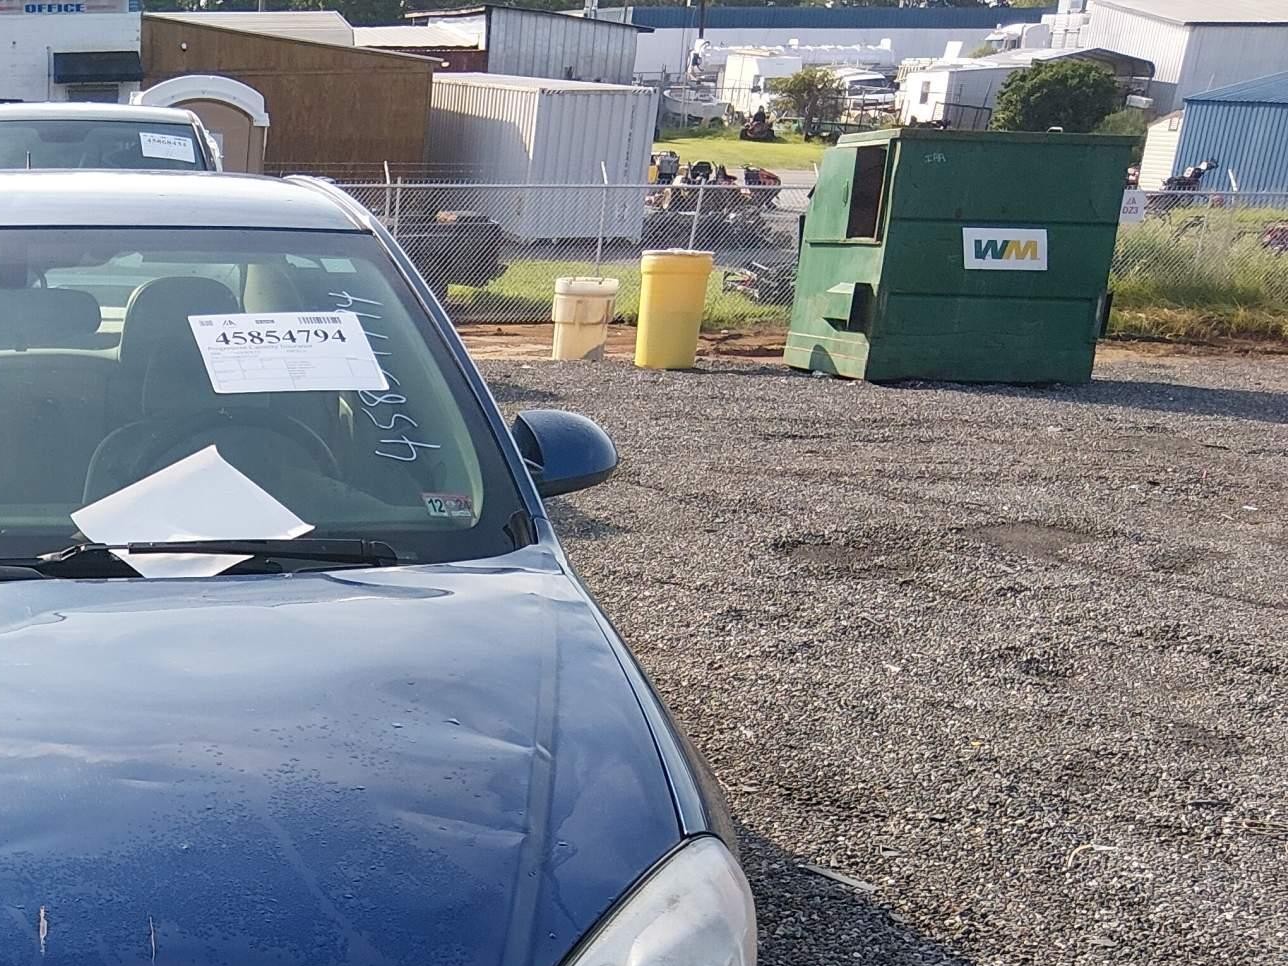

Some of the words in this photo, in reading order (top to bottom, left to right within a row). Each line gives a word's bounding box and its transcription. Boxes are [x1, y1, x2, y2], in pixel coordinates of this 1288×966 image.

[24, 3, 86, 13] OFFICE
[974, 239, 1038, 260] WM
[215, 328, 347, 345] 45854794
[427, 498, 446, 512] 12
